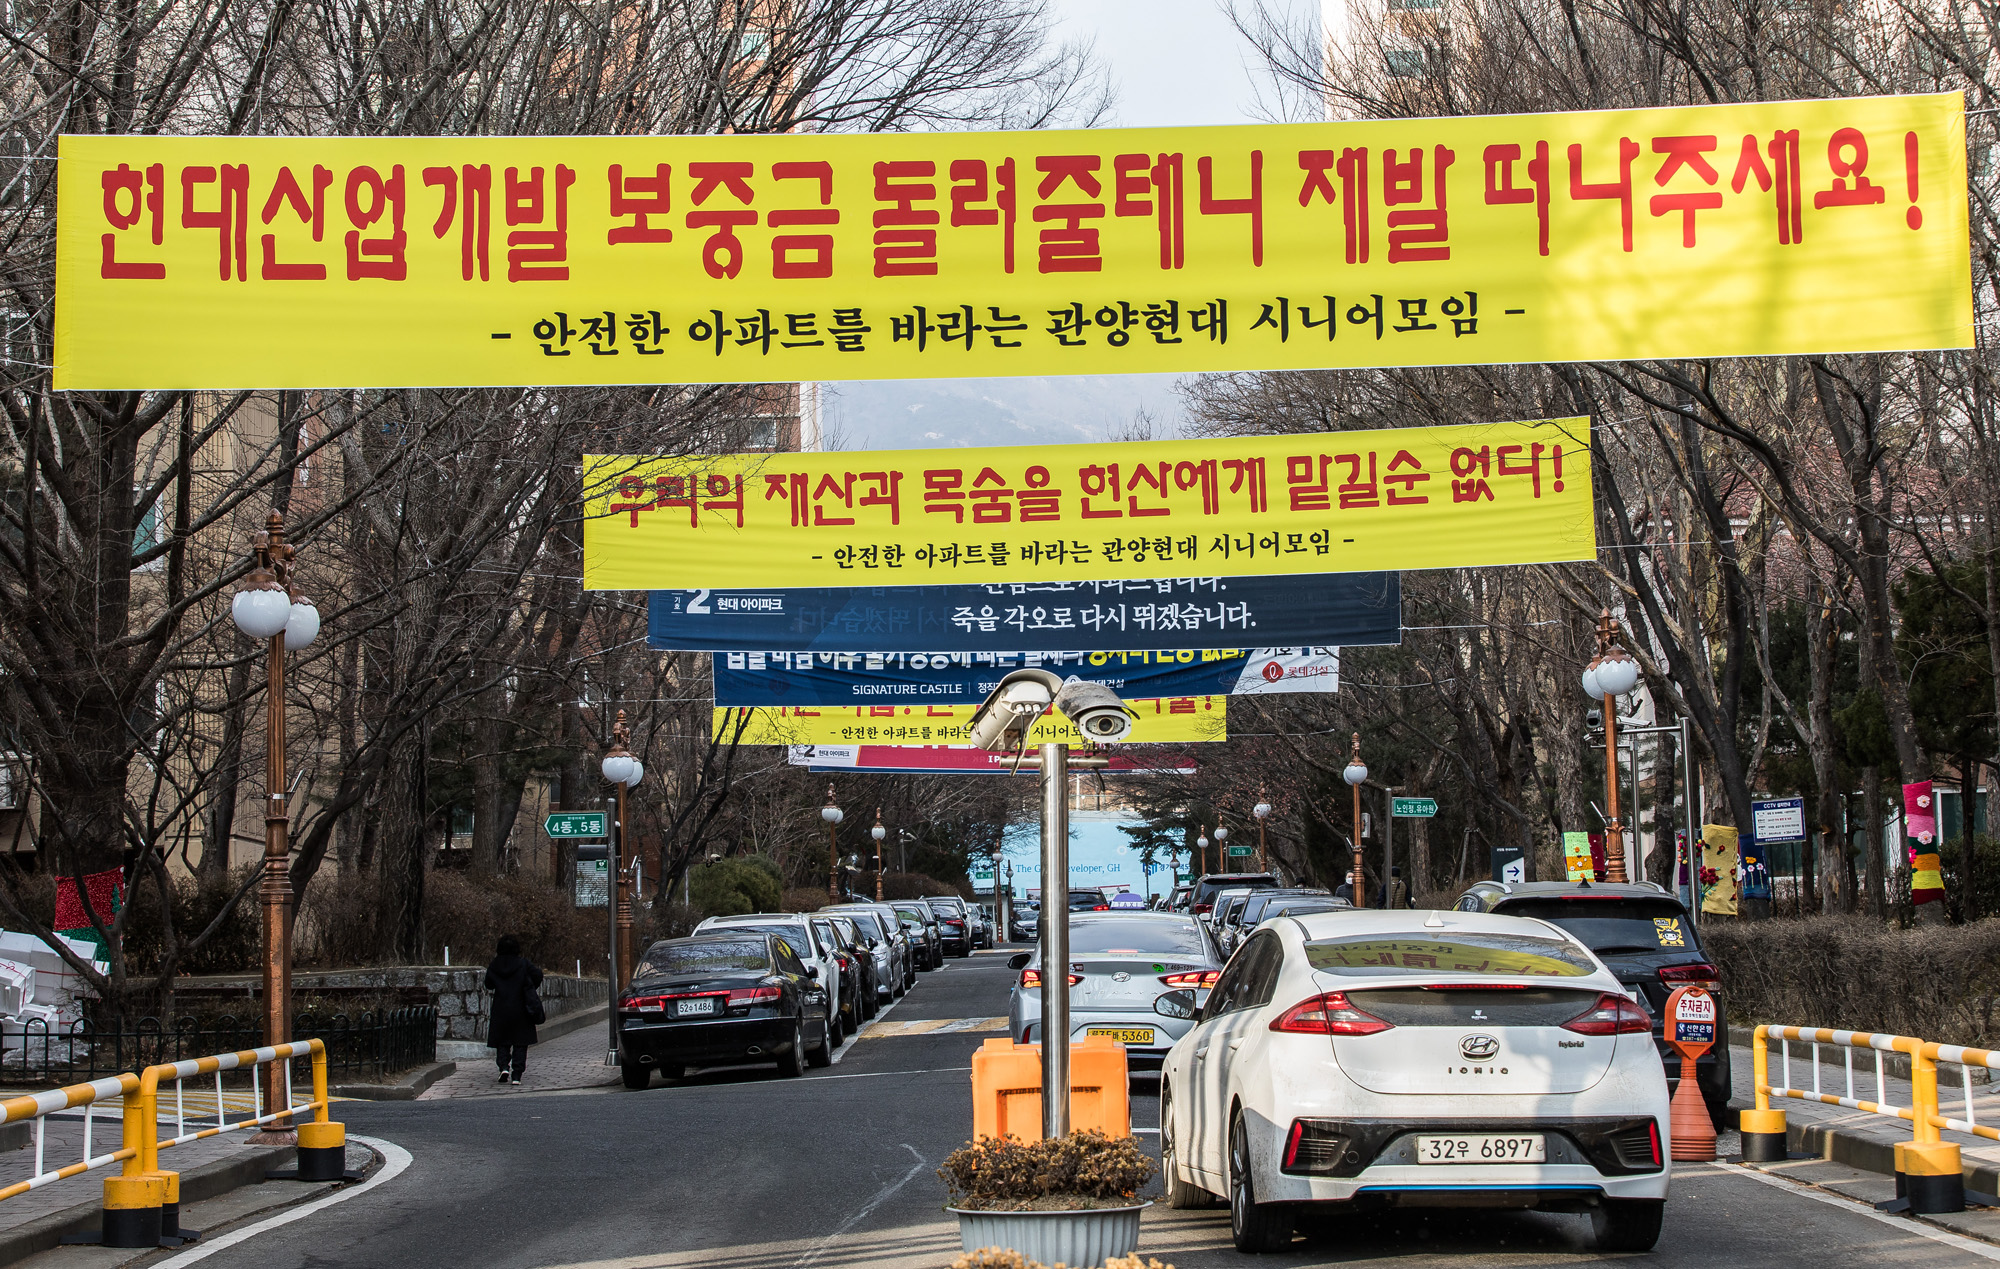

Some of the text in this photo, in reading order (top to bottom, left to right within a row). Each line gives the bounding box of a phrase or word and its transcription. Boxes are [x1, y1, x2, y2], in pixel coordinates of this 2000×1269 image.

[101, 163, 576, 282] 현대산업개발
[873, 150, 1263, 278] 돌려줄테니
[1299, 144, 1455, 264] 제발
[1483, 128, 1922, 256] 떠나주세요!
[533, 311, 670, 356] 안전한
[689, 308, 871, 356] 아파트를
[890, 305, 1027, 352] 바라는
[1046, 299, 1227, 346] 관양현대
[1250, 291, 1477, 343] 시니어모임
[609, 442, 1565, 529] 우리의 재산과 목숨을 현산에게 맡길순 없다!
[834, 544, 905, 568] 안전한
[915, 543, 1010, 568] 아파트를
[1021, 540, 1092, 565] 바라는
[1102, 535, 1196, 562] 관양현대
[1209, 529, 1329, 559] 시니어모임
[718, 598, 782, 610] 현대 아이파크
[951, 605, 1000, 632] 죽을
[1004, 605, 1075, 632] 각오로
[1080, 604, 1125, 631] 다시
[1133, 602, 1256, 630] 뛰겠습니다.
[1286, 665, 1330, 681] 롯데건설
[853, 684, 961, 694] SIGNATURE CASTLE
[977, 682, 1003, 694] 정직
[842, 727, 878, 739] 안전한
[884, 727, 932, 739] 아파트를
[938, 727, 973, 740] 바라는
[1033, 725, 1082, 739] 시니어모
[818, 750, 850, 758] 현대 아이파크
[1016, 864, 1032, 873] The
[1066, 864, 1106, 876] eveloper,
[1107, 864, 1121, 873] GH
[1680, 999, 1711, 1013] 주차금지
[1686, 1024, 1712, 1034] 신한은행
[1121, 1030, 1150, 1042] 5360
[1558, 1040, 1585, 1050] hybrid
[1447, 1066, 1509, 1075] IONIQ
[1431, 1139, 1532, 1158] 32우 6897
